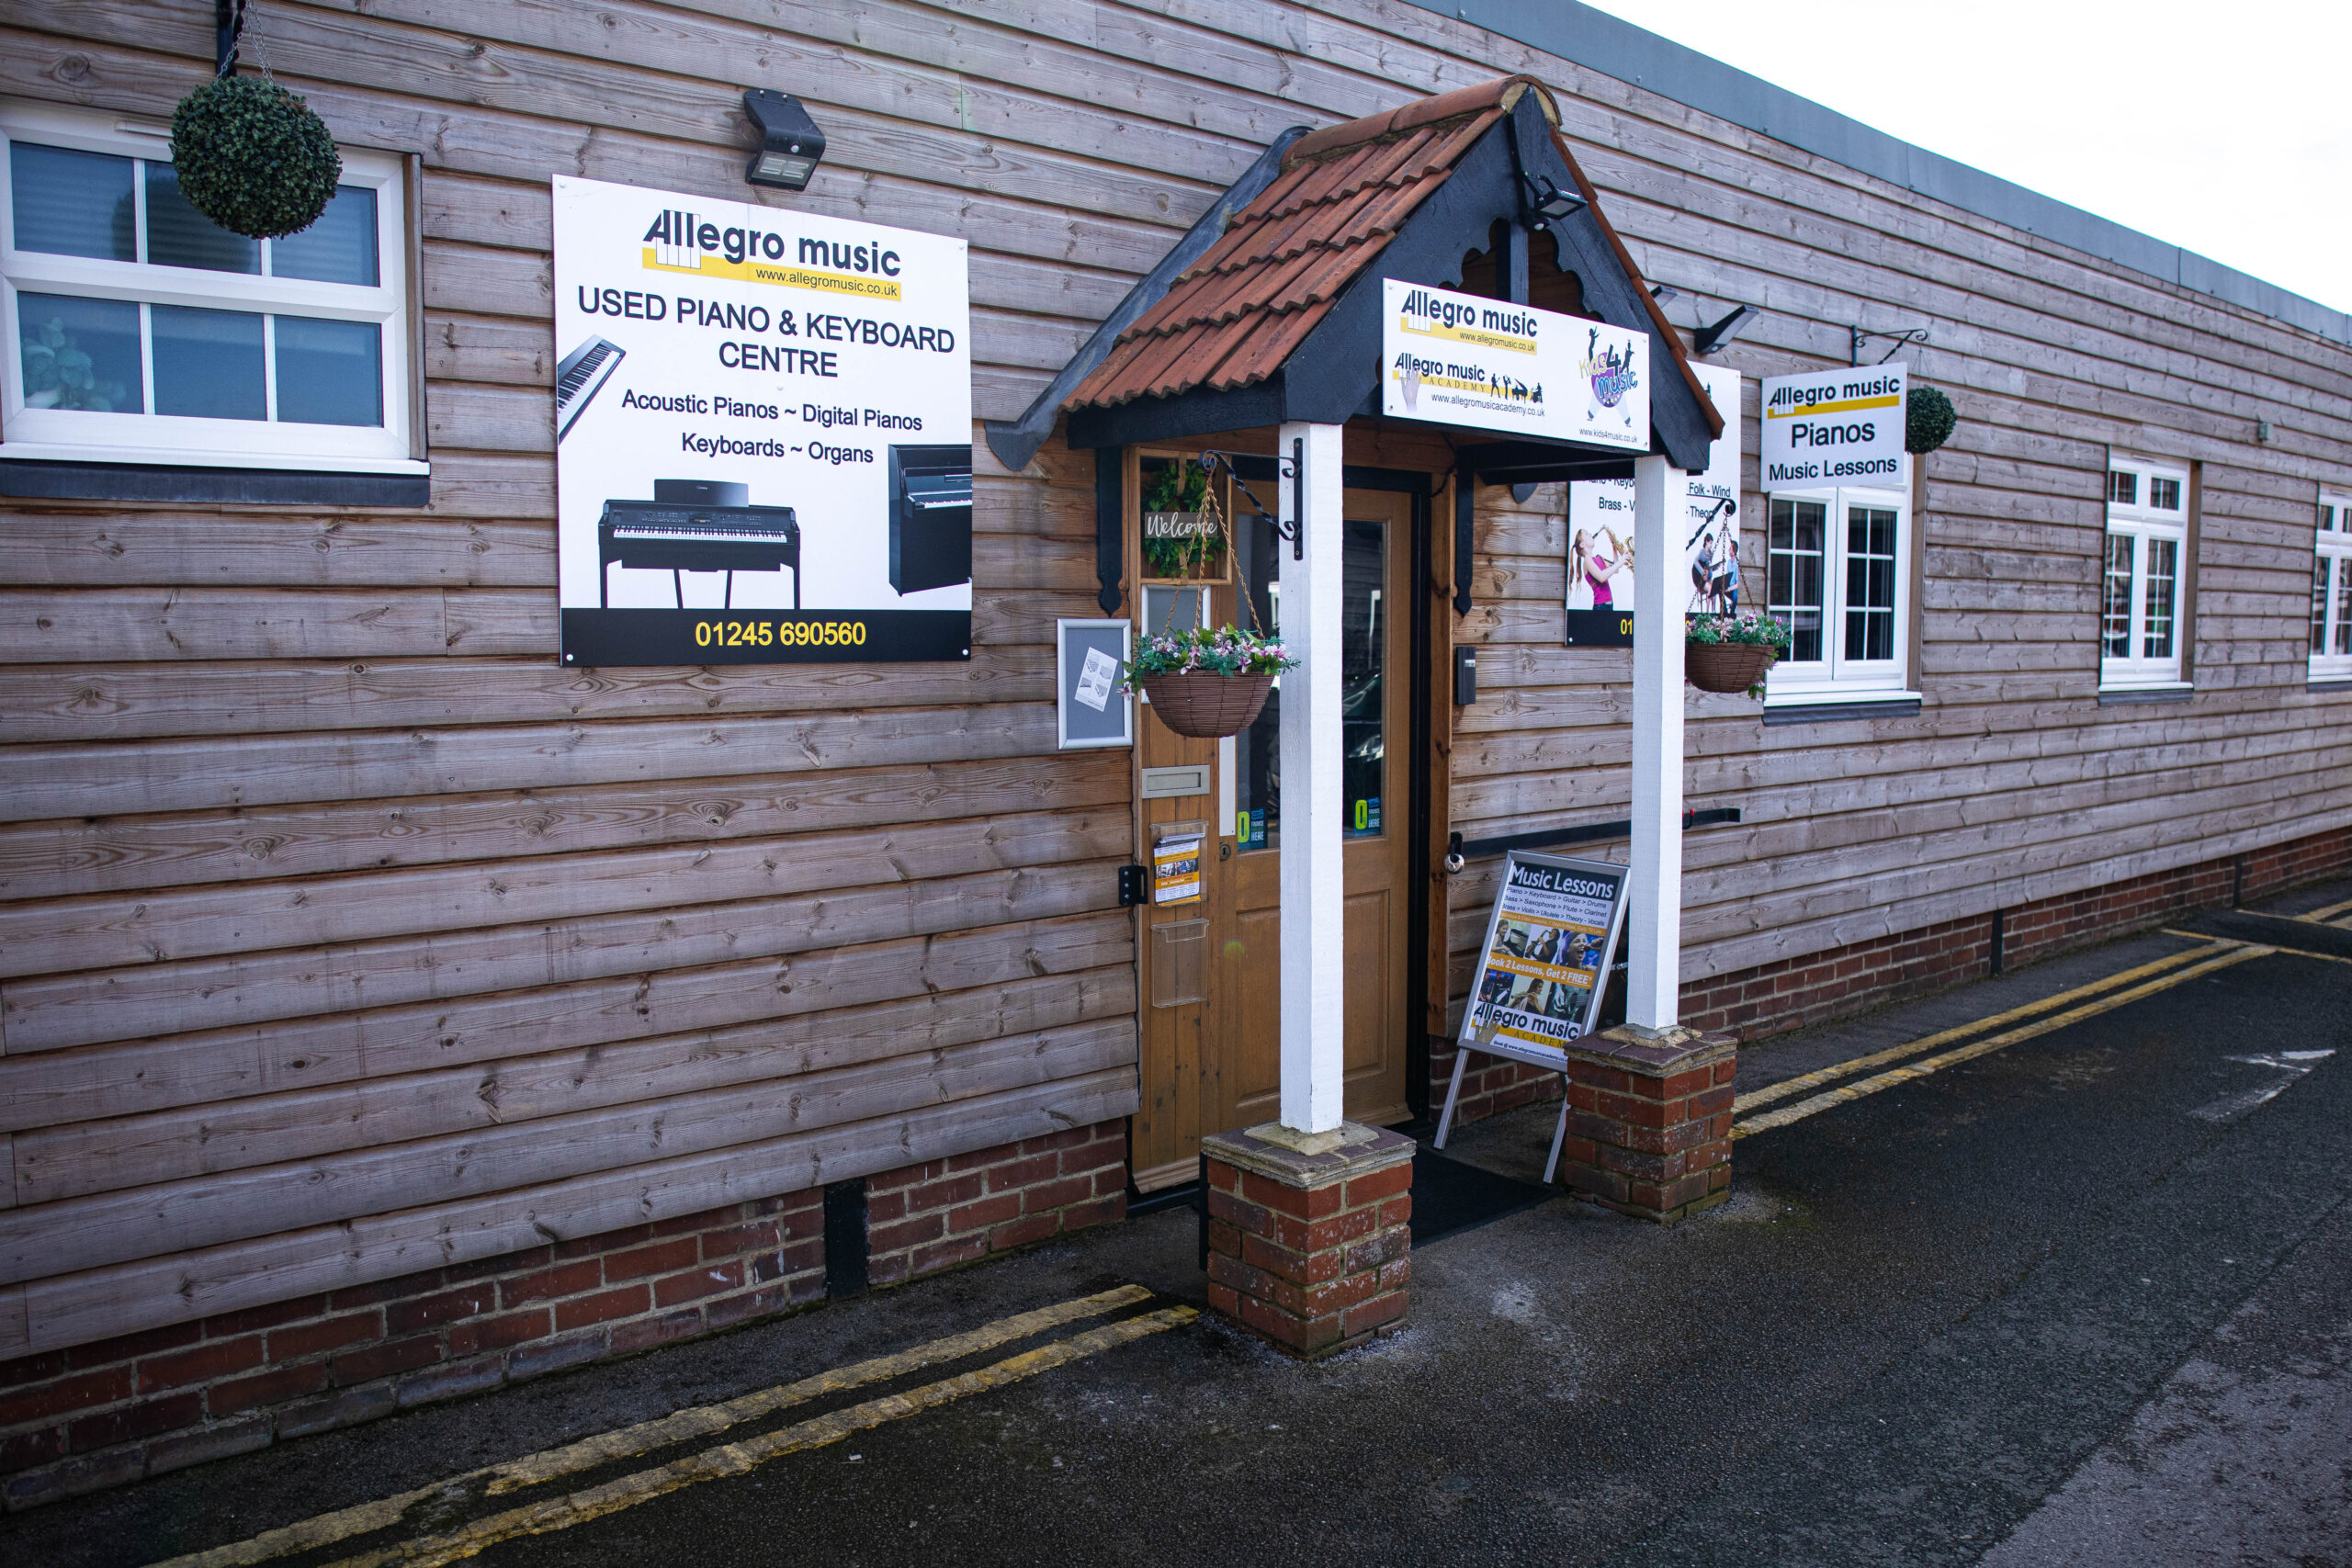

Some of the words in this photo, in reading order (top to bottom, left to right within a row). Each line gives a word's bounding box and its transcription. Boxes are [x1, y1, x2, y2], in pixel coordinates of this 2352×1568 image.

[643, 209, 786, 264] Allegro
[798, 237, 901, 276] music
[755, 267, 898, 299] www.allegromusic.co.uk
[578, 285, 666, 321] USED
[677, 298, 770, 333] PIANO
[778, 310, 797, 335] &
[807, 312, 956, 353] KEYBOARD
[1401, 289, 1476, 329] Allegro
[1483, 309, 1538, 337] music
[1459, 331, 1535, 353] www.allegromusic.co.uk
[718, 342, 838, 378] CENTRE
[1395, 353, 1443, 377] Allegro
[1447, 360, 1485, 382] music
[1606, 344, 1622, 377] 4
[1428, 377, 1487, 392] ACADEMY
[1597, 370, 1639, 399] music
[1769, 386, 1837, 407] Allegro
[1843, 376, 1900, 399] music
[622, 389, 708, 415] Acoustic
[714, 396, 779, 420] Pianos
[802, 403, 858, 430] Digital
[864, 408, 922, 431] Pianos
[1430, 392, 1545, 418] www.allegromusicacademy.co.uk
[1578, 427, 1638, 443] www.kids4music.co.uk
[1791, 422, 1876, 448] Pianos
[682, 433, 785, 458] Keyboards
[808, 441, 874, 466] Organs
[1769, 462, 1819, 481] Music
[1824, 458, 1897, 478] Lessons
[1689, 481, 1705, 495] Folk
[1712, 484, 1731, 498] Wind
[1599, 496, 1622, 511] Brass
[1147, 511, 1218, 537] Welcome
[695, 622, 773, 647] 01245
[779, 622, 866, 648] 690560
[1251, 831, 1264, 840] HERE
[1510, 865, 1552, 889] Music
[1554, 872, 1614, 898] Lessons
[1524, 897, 1556, 909] Saxophone
[1563, 904, 1577, 913] Flute
[1584, 908, 1607, 918] Clarinet
[1529, 888, 1556, 900] Keyboard
[1563, 896, 1580, 904] Guitar
[1587, 899, 1607, 908] Drums
[1540, 909, 1560, 919] Ukulele
[1566, 914, 1583, 924] Theory
[1588, 917, 1605, 926] Vocals
[1506, 960, 1510, 968] 2
[1511, 961, 1544, 976] Lessons,
[1545, 967, 1560, 979] Get
[1561, 971, 1566, 979] 2
[1474, 1003, 1528, 1028] Allegro
[1531, 1018, 1578, 1040] music
[1513, 1031, 1567, 1048] ACADEM
